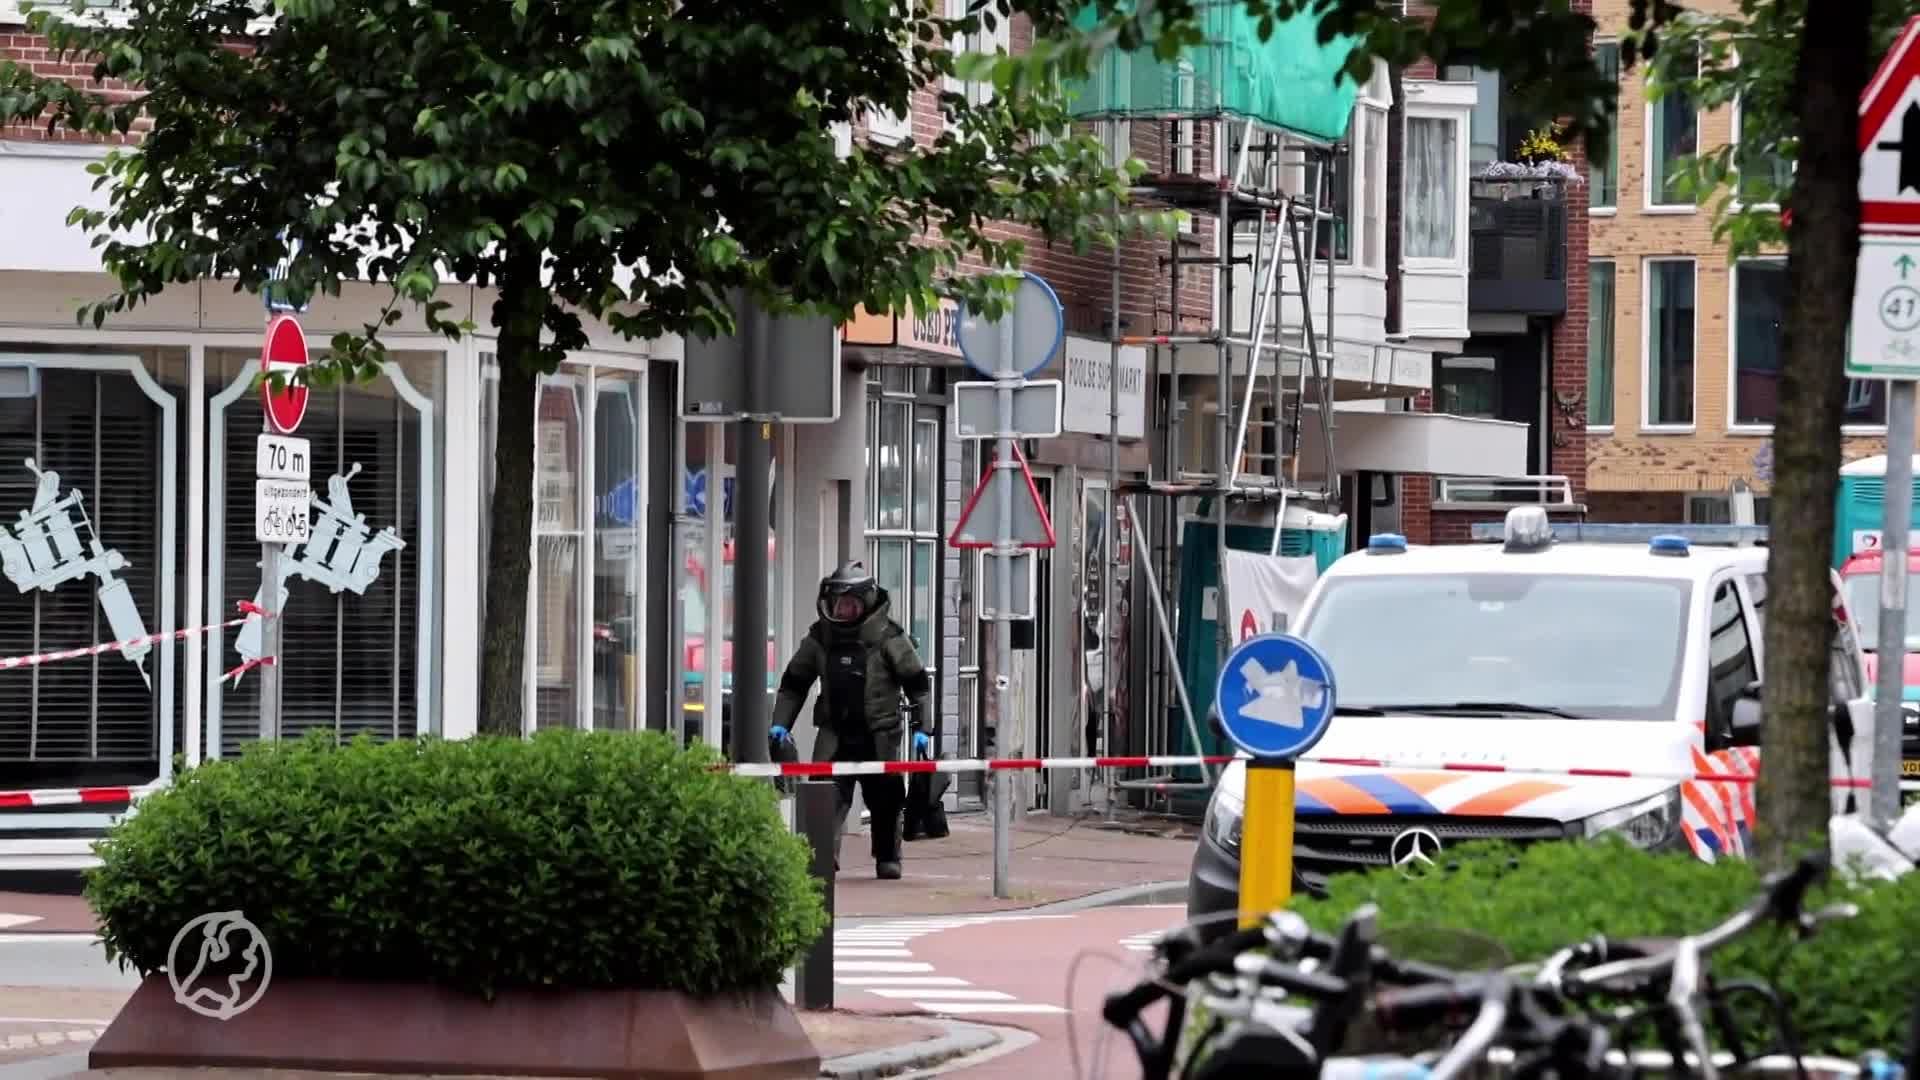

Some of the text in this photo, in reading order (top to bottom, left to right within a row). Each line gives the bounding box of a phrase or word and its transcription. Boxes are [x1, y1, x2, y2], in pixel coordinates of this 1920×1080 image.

[1886, 298, 1915, 318] 41
[1097, 360, 1143, 394] SUPMARKT
[268, 443, 305, 473] 70 m
